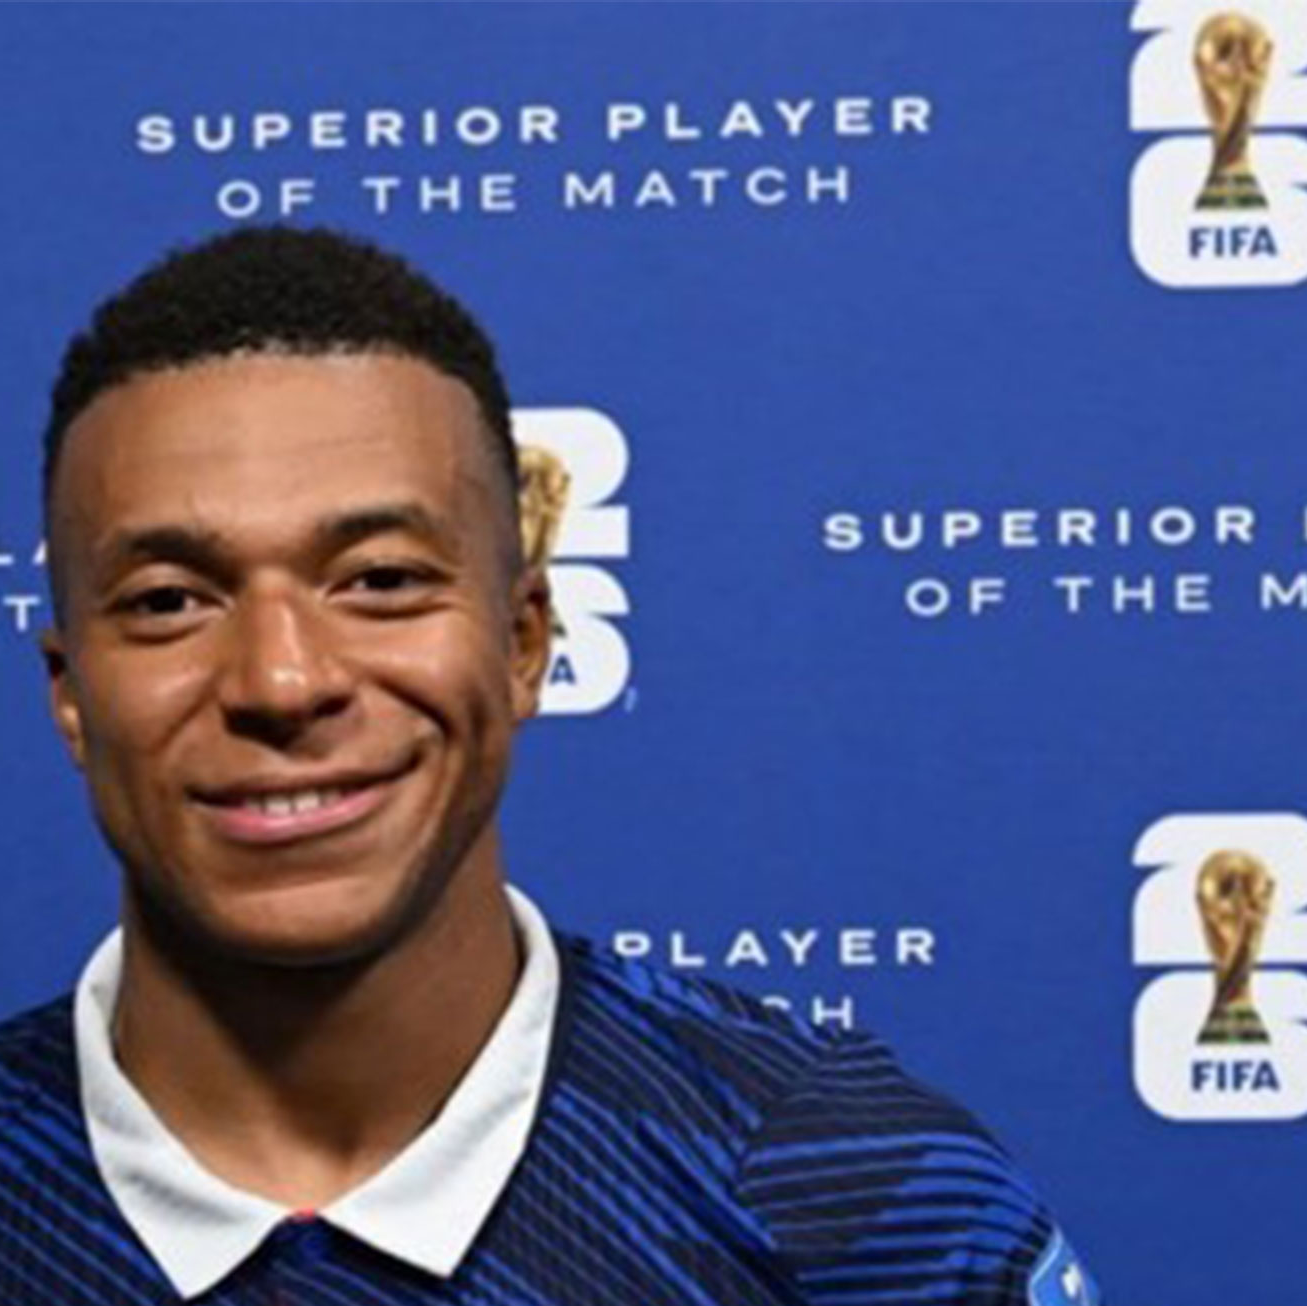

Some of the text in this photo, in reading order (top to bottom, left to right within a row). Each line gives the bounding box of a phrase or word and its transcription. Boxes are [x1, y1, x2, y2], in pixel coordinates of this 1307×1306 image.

[137, 96, 930, 153] SUPERIOR PLAYER
[217, 166, 848, 219] OF THE MATCH
[1188, 225, 1278, 258] FIFA
[824, 506, 1254, 551] SUPERIOR
[905, 574, 1210, 617] OF THE
[613, 928, 935, 967] PLAYER
[1191, 1059, 1280, 1092] FIFA
